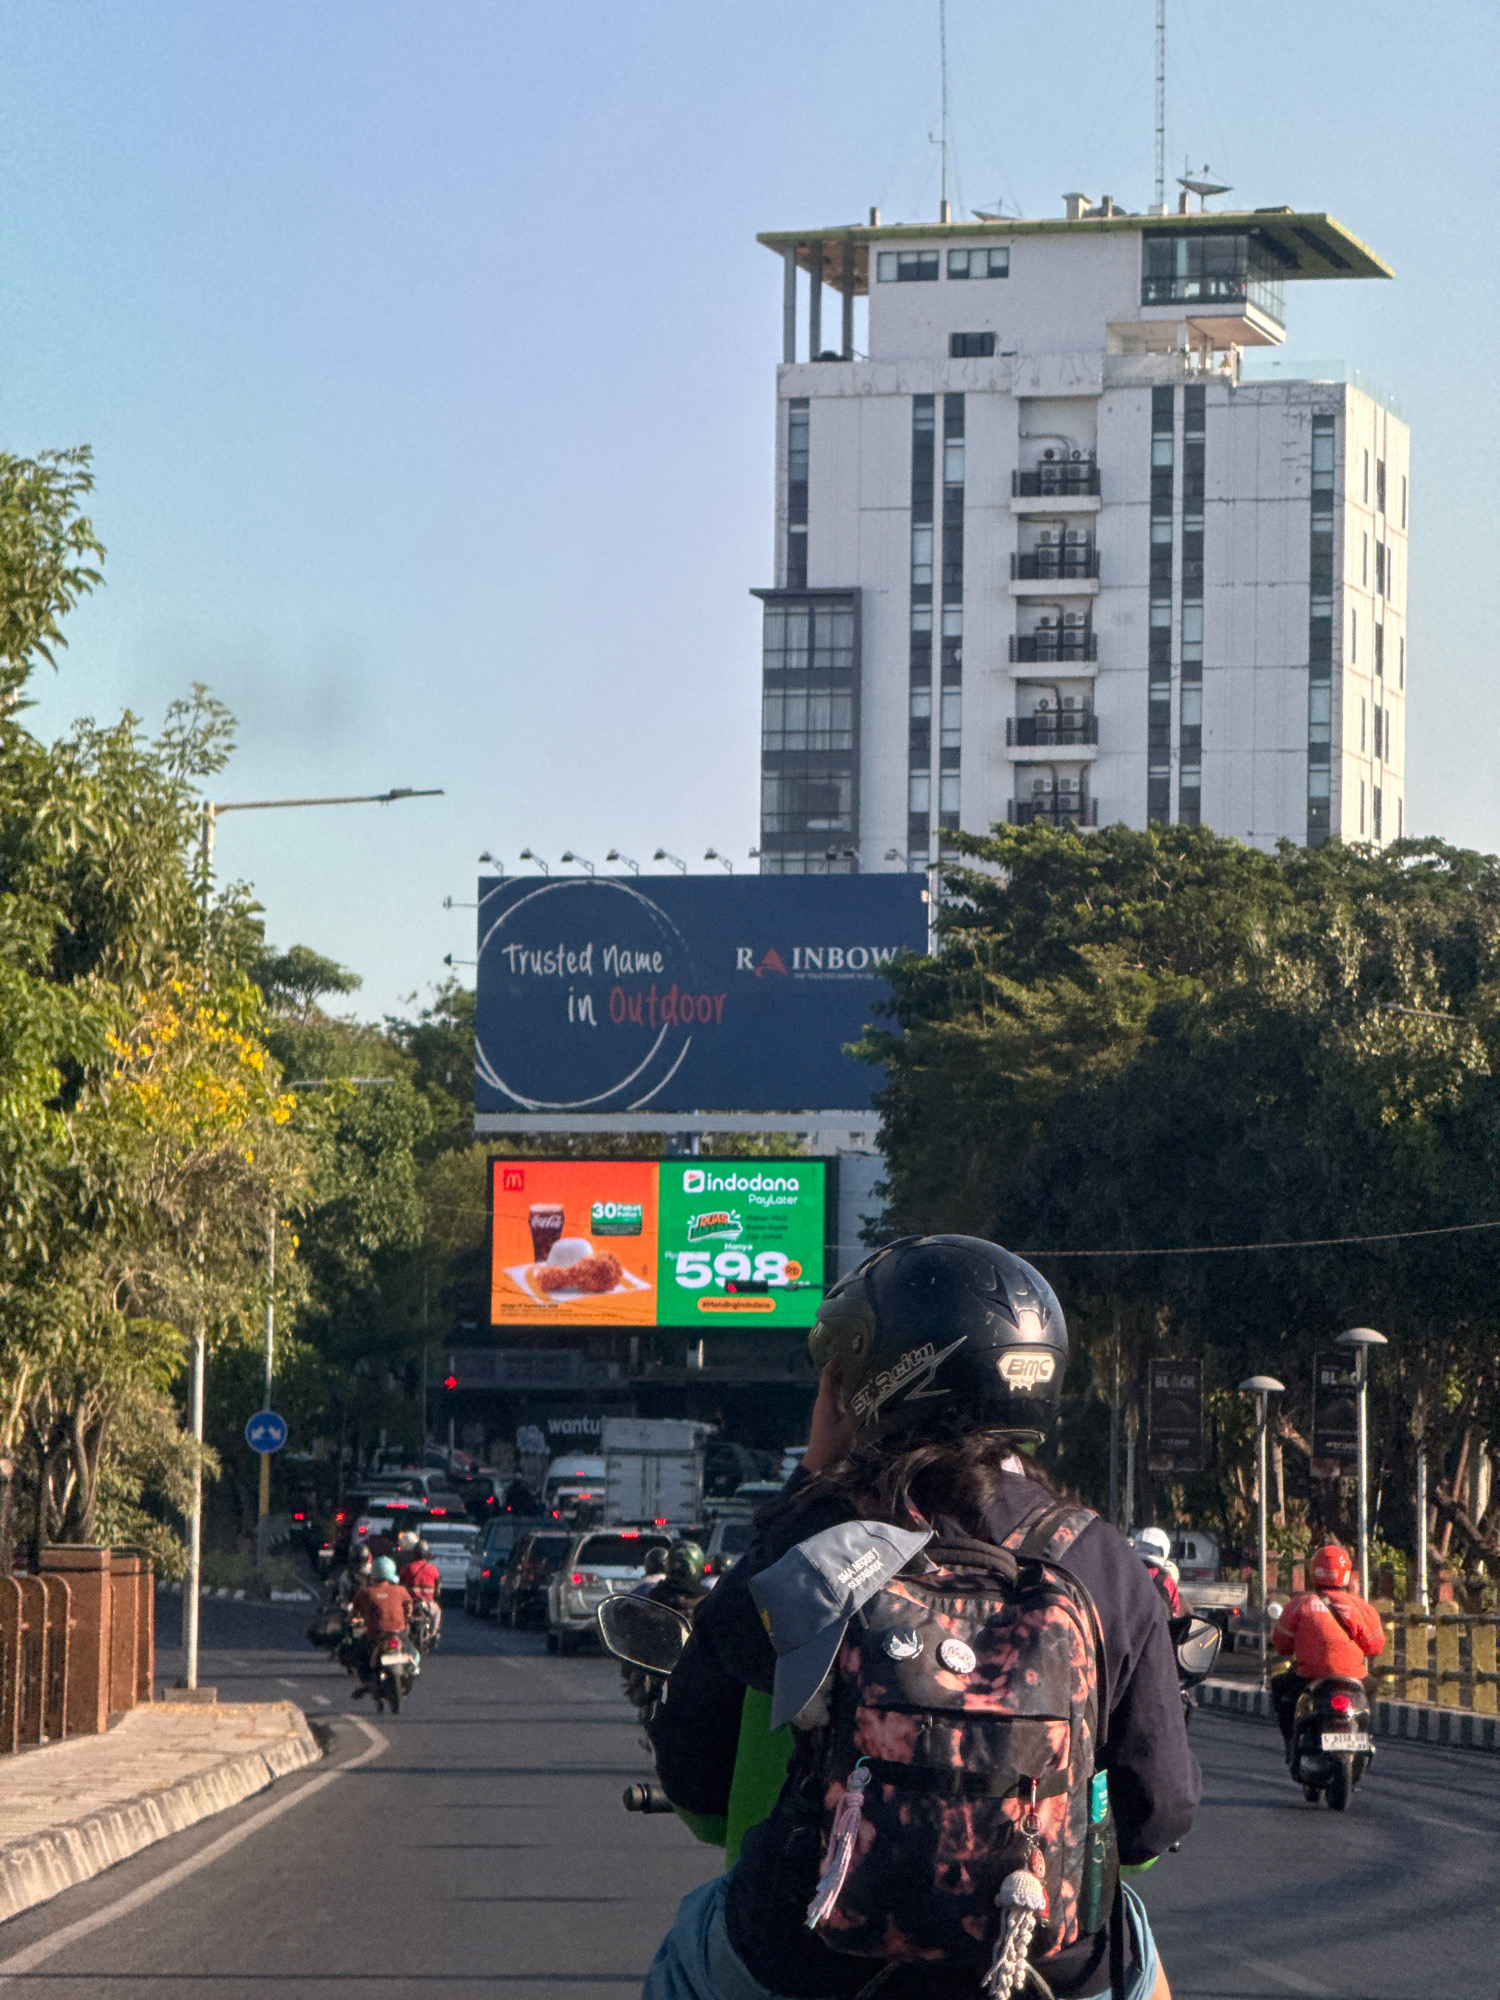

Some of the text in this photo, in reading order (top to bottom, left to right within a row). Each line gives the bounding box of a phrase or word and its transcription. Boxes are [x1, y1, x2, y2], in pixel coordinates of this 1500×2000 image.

[502, 942, 665, 977] Trusted Name
[567, 982, 728, 1028] in Outdoor
[707, 1172, 800, 1191] indodana
[591, 1202, 617, 1219] 30
[748, 1194, 799, 1207] PayLater
[675, 1251, 790, 1289] 598
[1006, 1358, 1051, 1379] BMC
[1321, 1370, 1359, 1385] BLAC
[838, 1567, 857, 1584] SMA
[852, 1550, 876, 1572] NEGERI
[847, 1560, 884, 1589] SURABAYA
